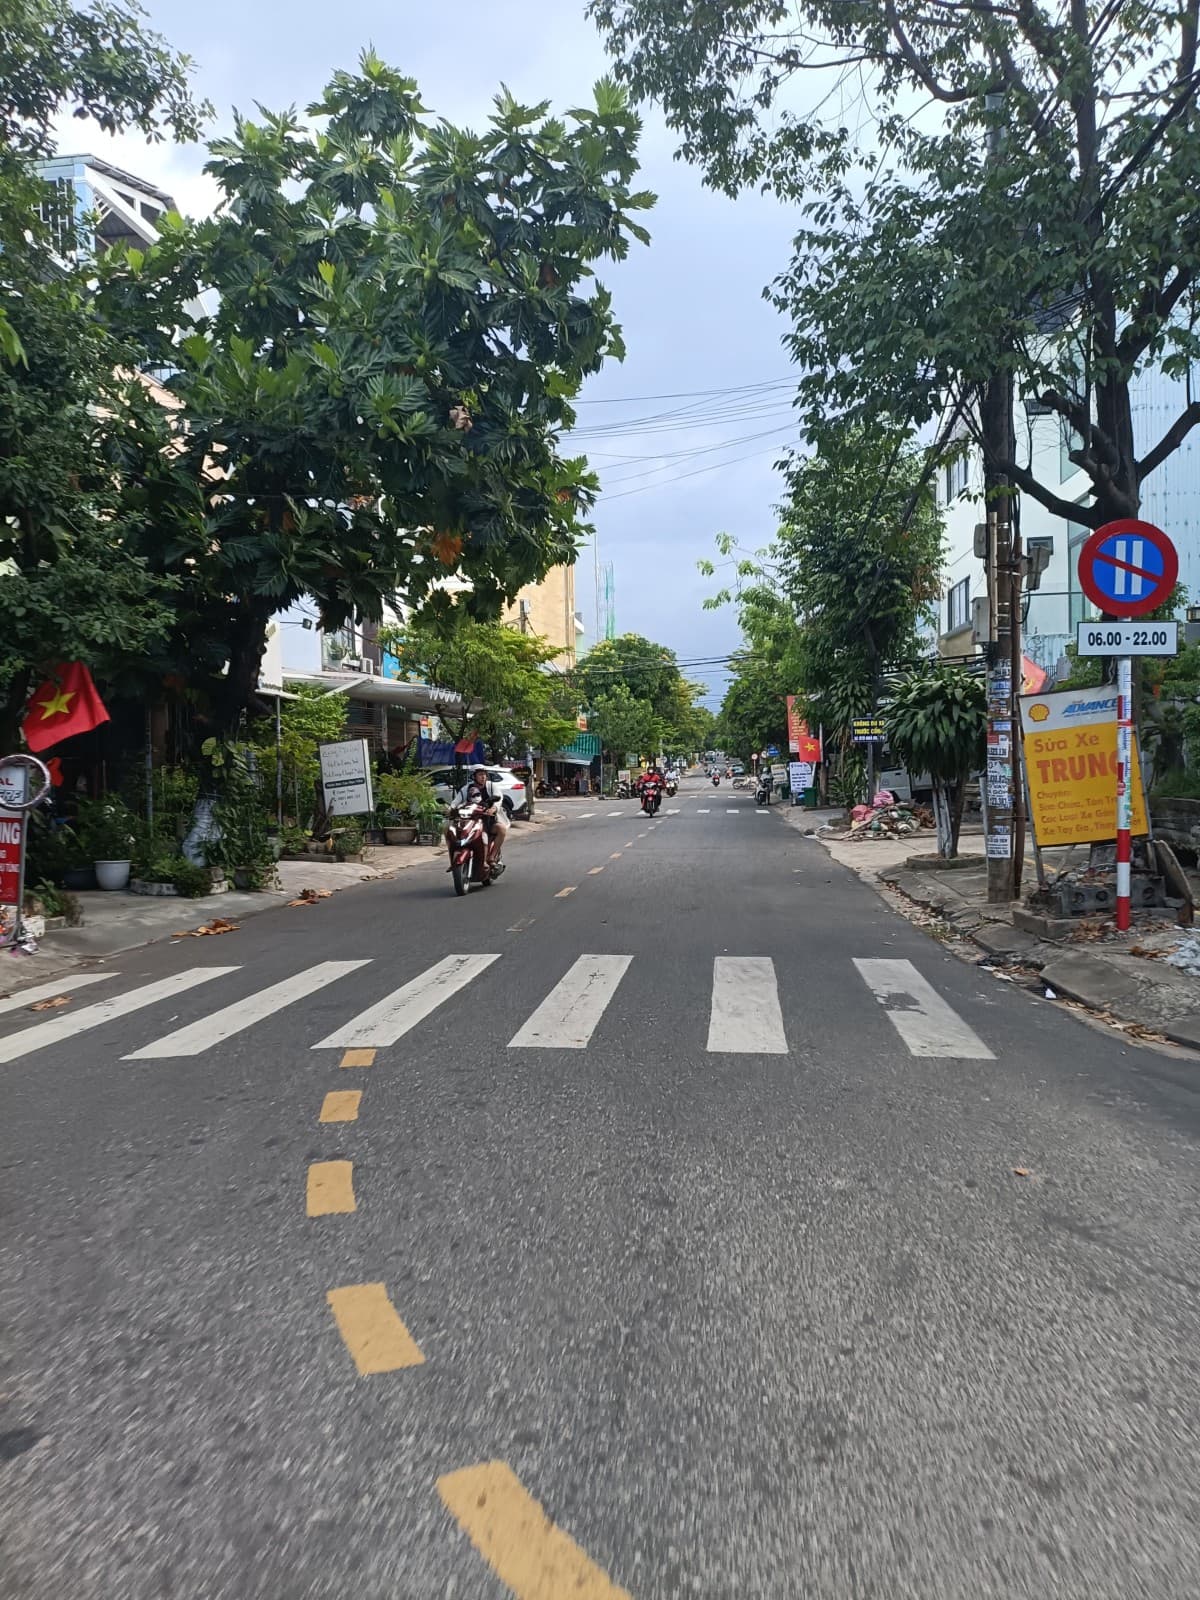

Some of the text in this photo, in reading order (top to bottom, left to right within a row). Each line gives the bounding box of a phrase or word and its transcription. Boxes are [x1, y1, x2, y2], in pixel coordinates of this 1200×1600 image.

[1088, 632, 1121, 646] 06.00
[1133, 632, 1167, 645] 22.00
[1075, 732, 1099, 748] Xe
